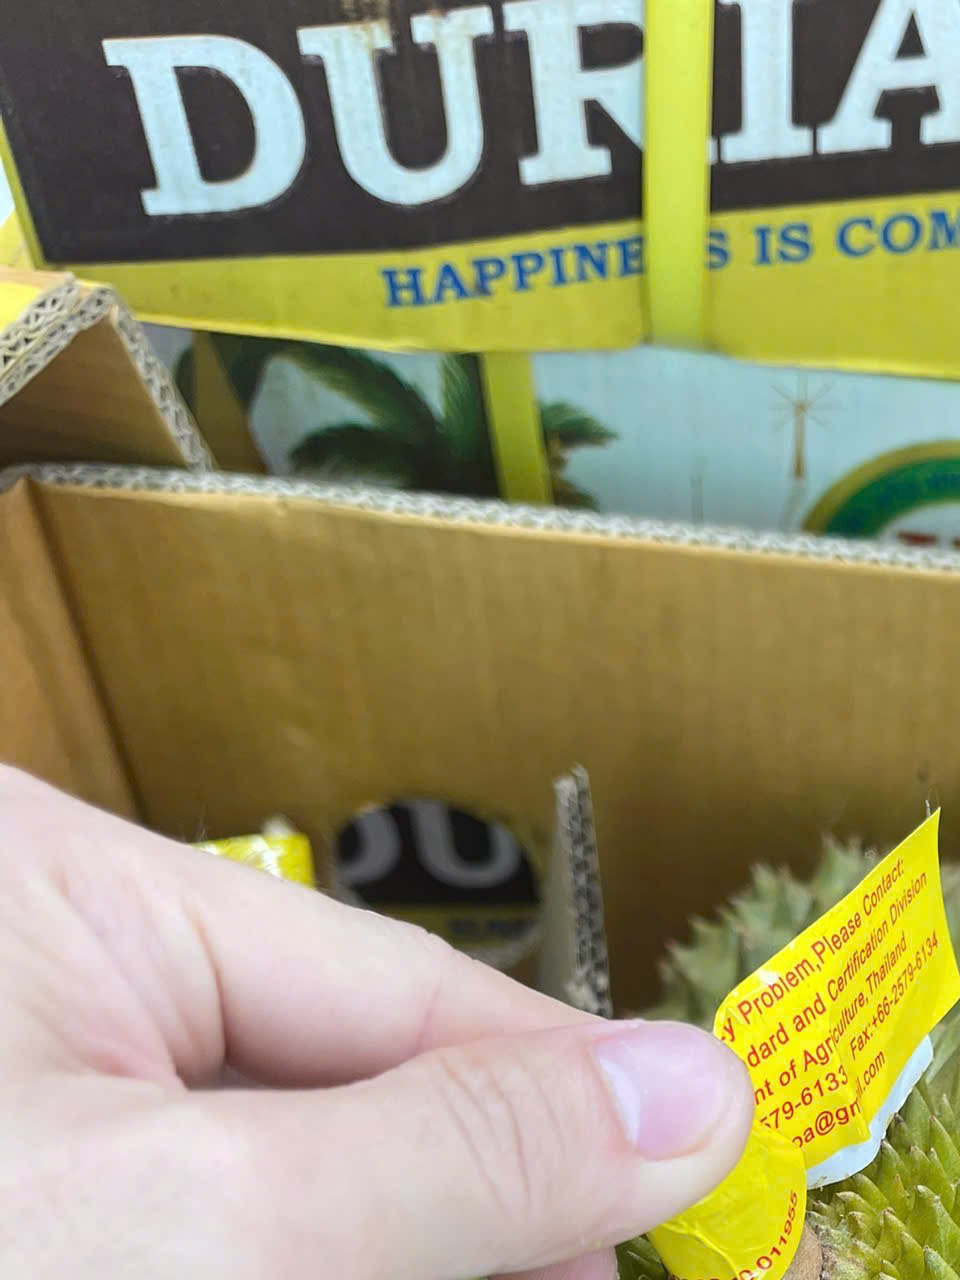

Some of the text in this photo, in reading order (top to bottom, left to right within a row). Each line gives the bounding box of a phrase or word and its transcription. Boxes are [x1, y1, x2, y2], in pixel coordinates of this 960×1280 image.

[381, 229, 731, 308] HAPPINES
[755, 222, 812, 266] IS
[862, 857, 906, 917] Contact:
[746, 1022, 790, 1068] dard
[792, 992, 827, 1033] and
[827, 919, 889, 1002] Certification
[888, 871, 928, 927] Division
[778, 1060, 798, 1088] of
